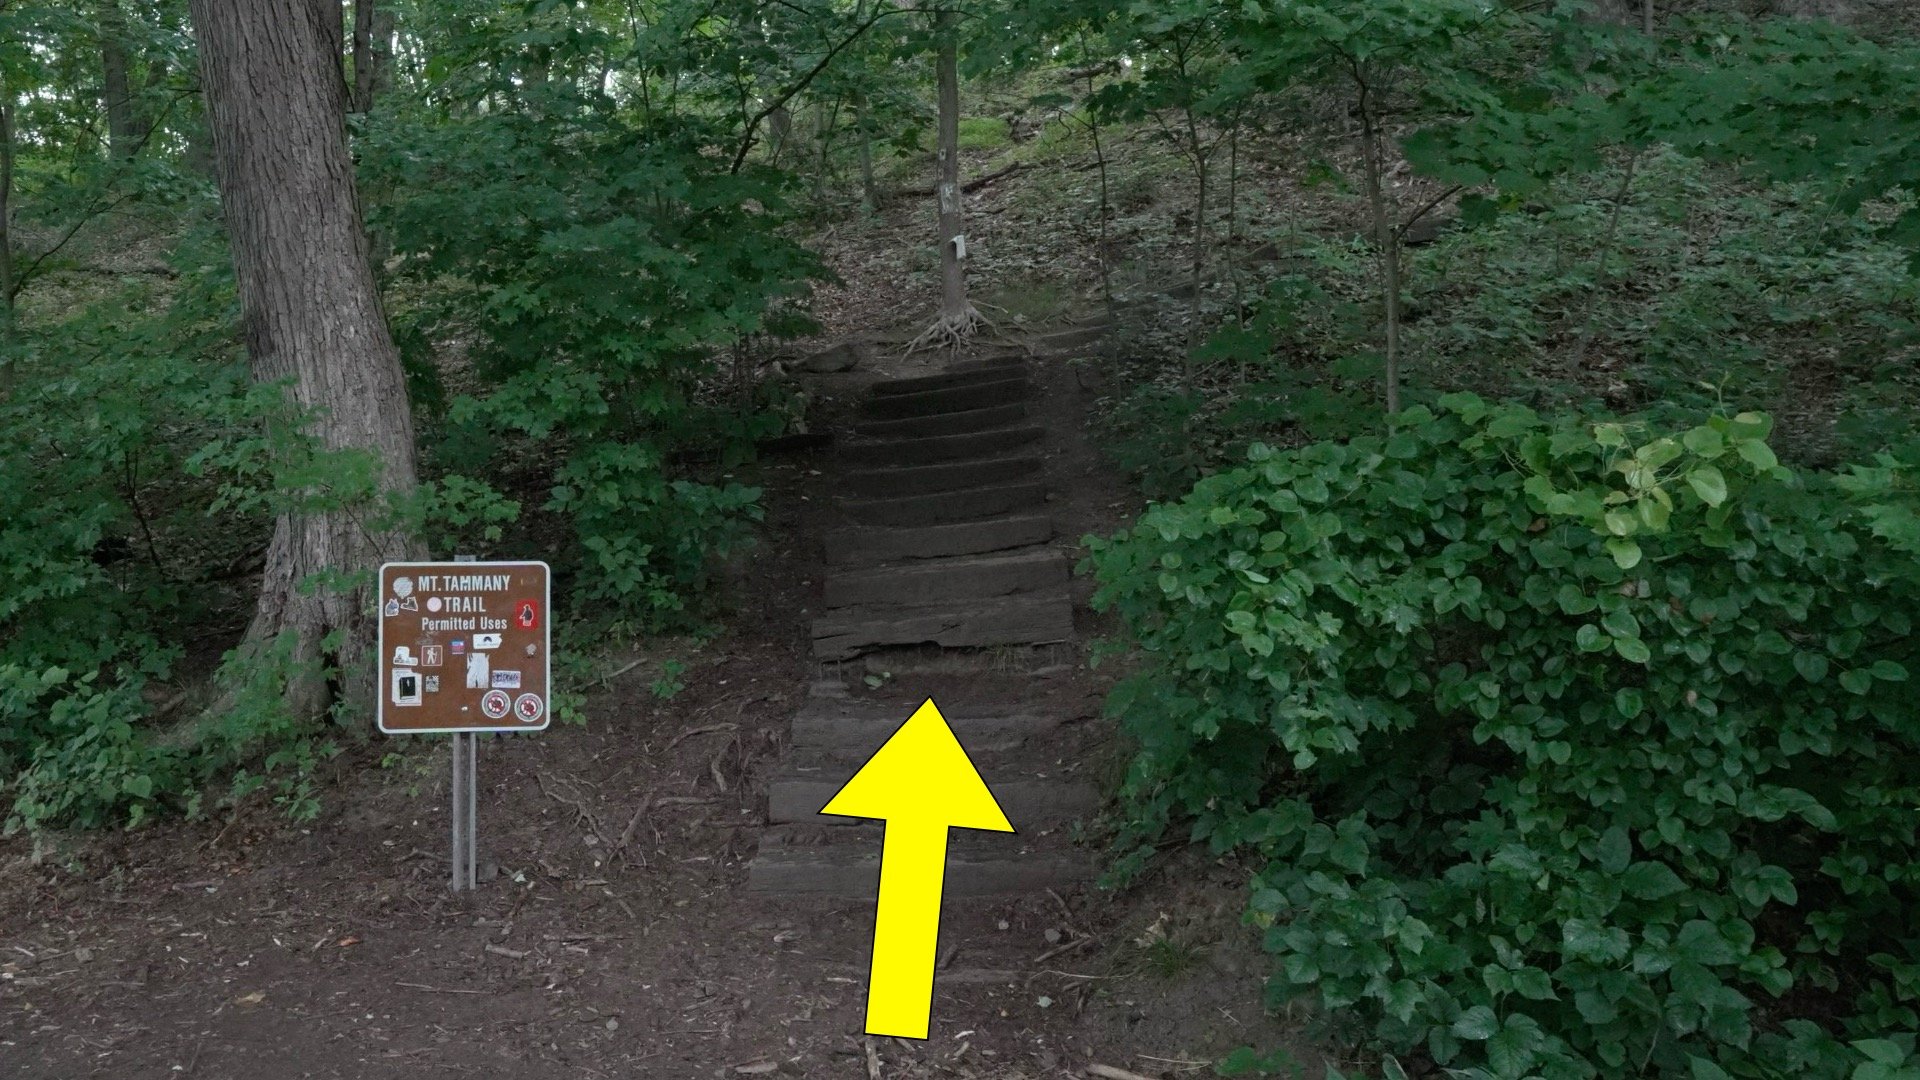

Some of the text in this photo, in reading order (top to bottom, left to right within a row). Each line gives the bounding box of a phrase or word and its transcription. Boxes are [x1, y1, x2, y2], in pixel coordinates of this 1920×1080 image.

[418, 575, 510, 591] MT. TAMMANY
[443, 596, 486, 611] TRAIL
[421, 616, 507, 629] Permitted Uses
